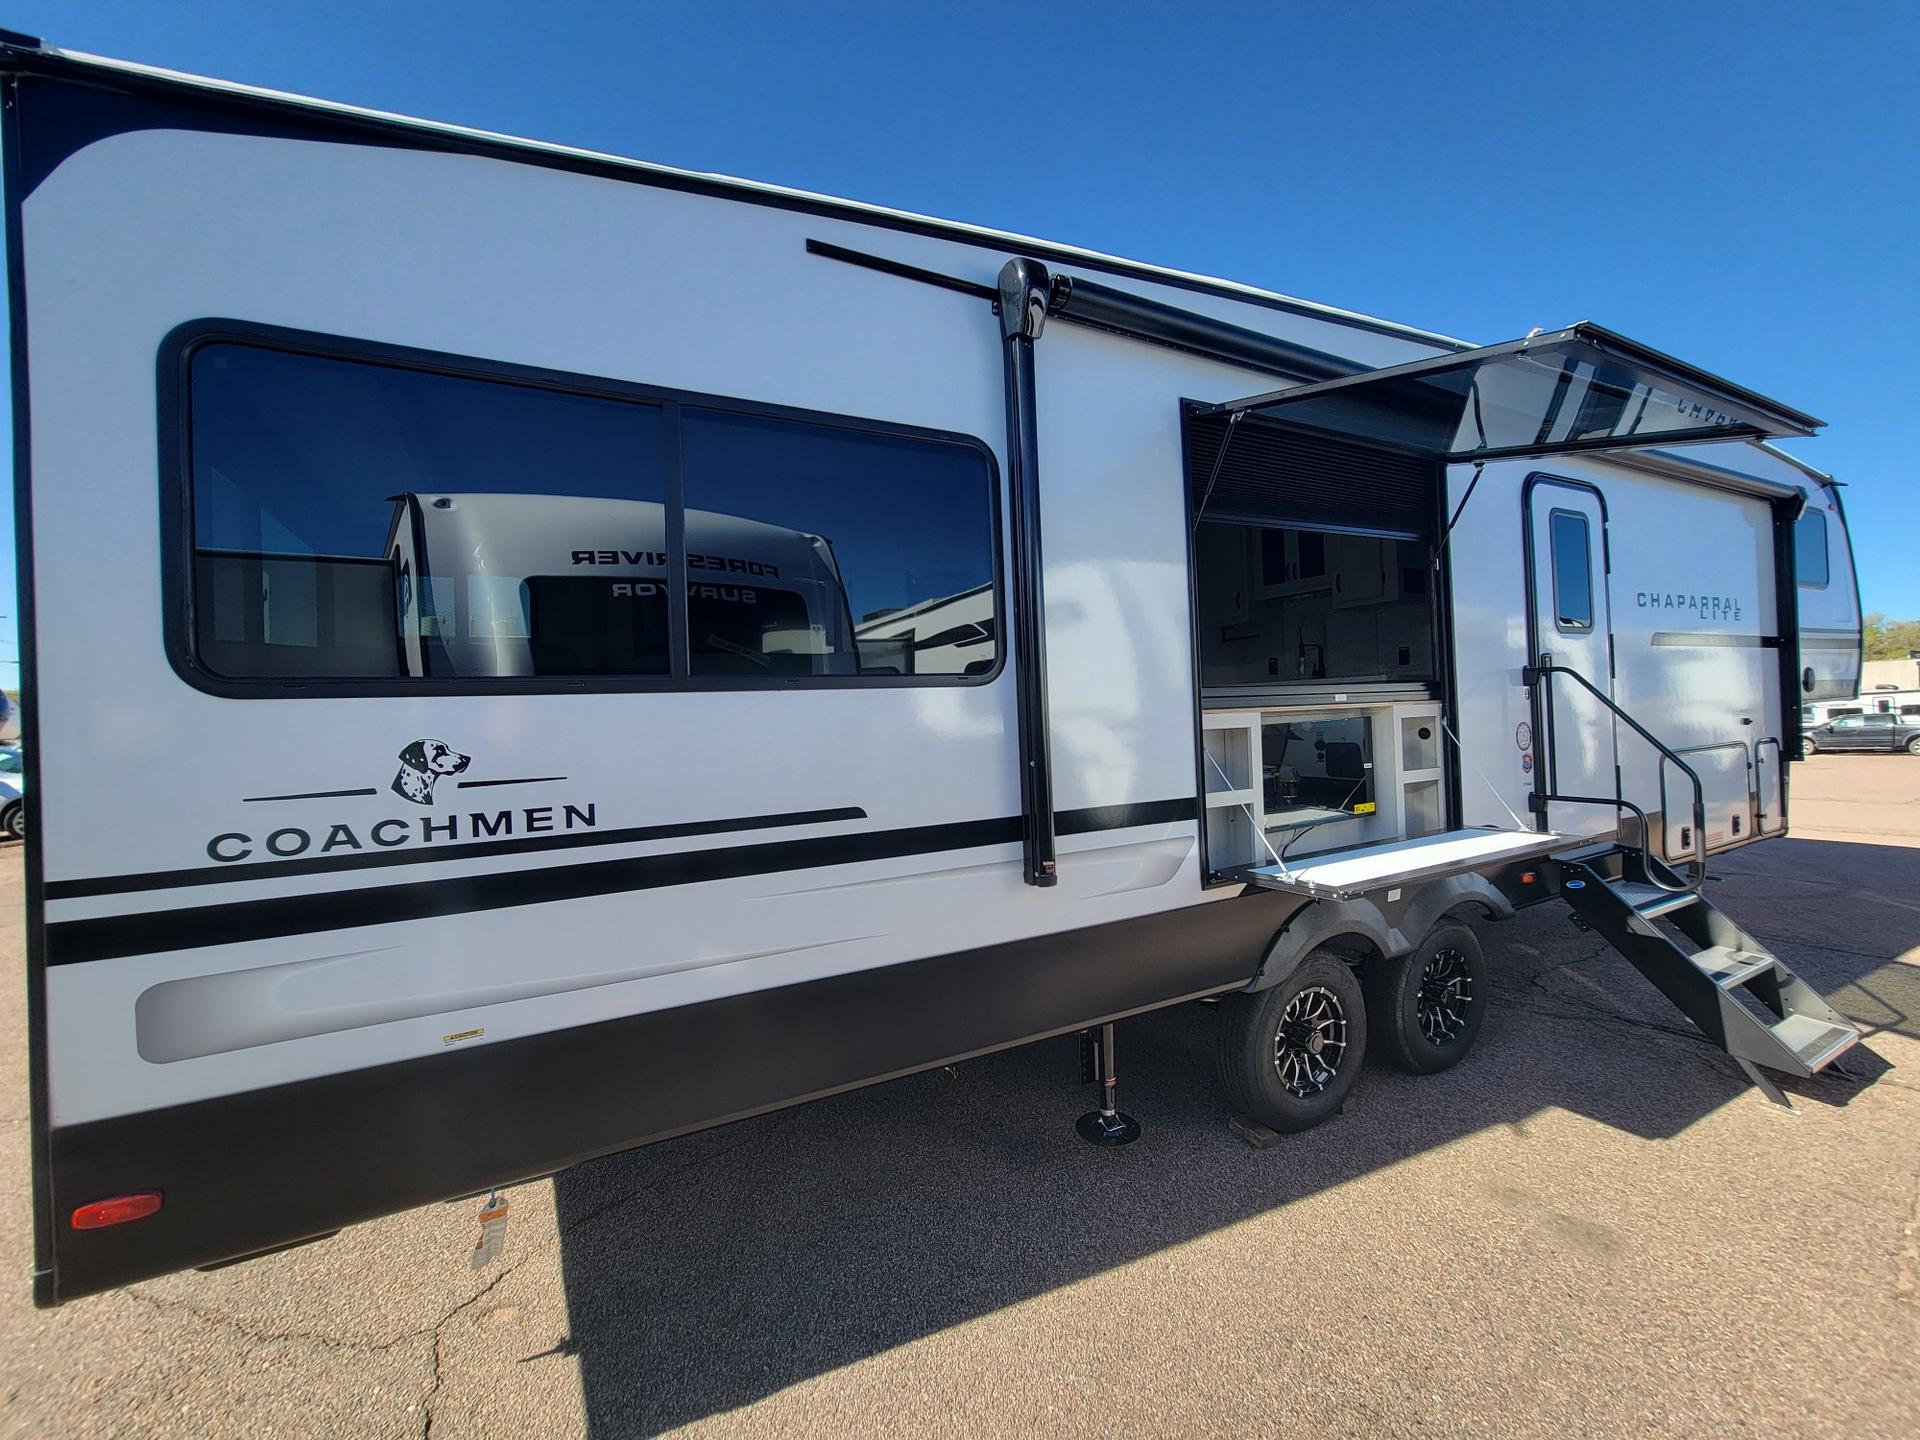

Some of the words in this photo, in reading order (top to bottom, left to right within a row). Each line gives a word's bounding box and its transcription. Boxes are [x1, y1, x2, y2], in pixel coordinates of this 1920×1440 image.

[1637, 592, 1741, 611] CHAPARRAL
[1700, 610, 1741, 621] LITE
[206, 803, 596, 862] COACHMEN
